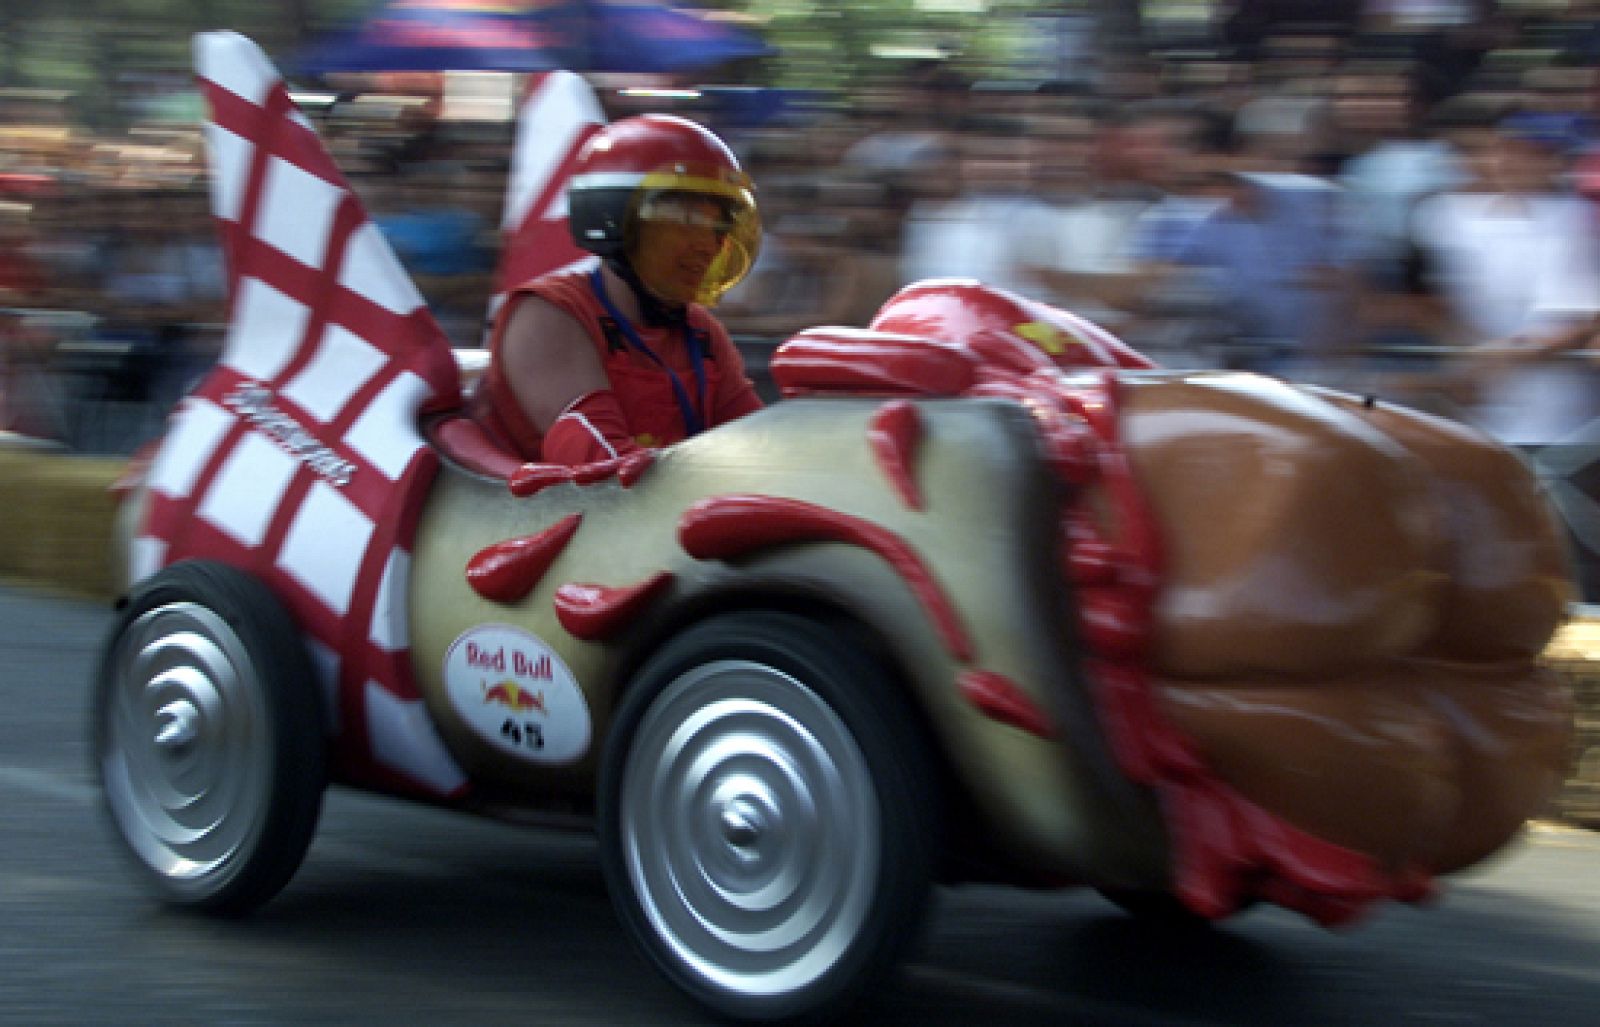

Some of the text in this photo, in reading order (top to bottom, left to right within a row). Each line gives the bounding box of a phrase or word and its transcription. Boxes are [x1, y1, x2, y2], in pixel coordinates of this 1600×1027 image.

[466, 640, 553, 682] Red Bull
[501, 718, 545, 751] 45
